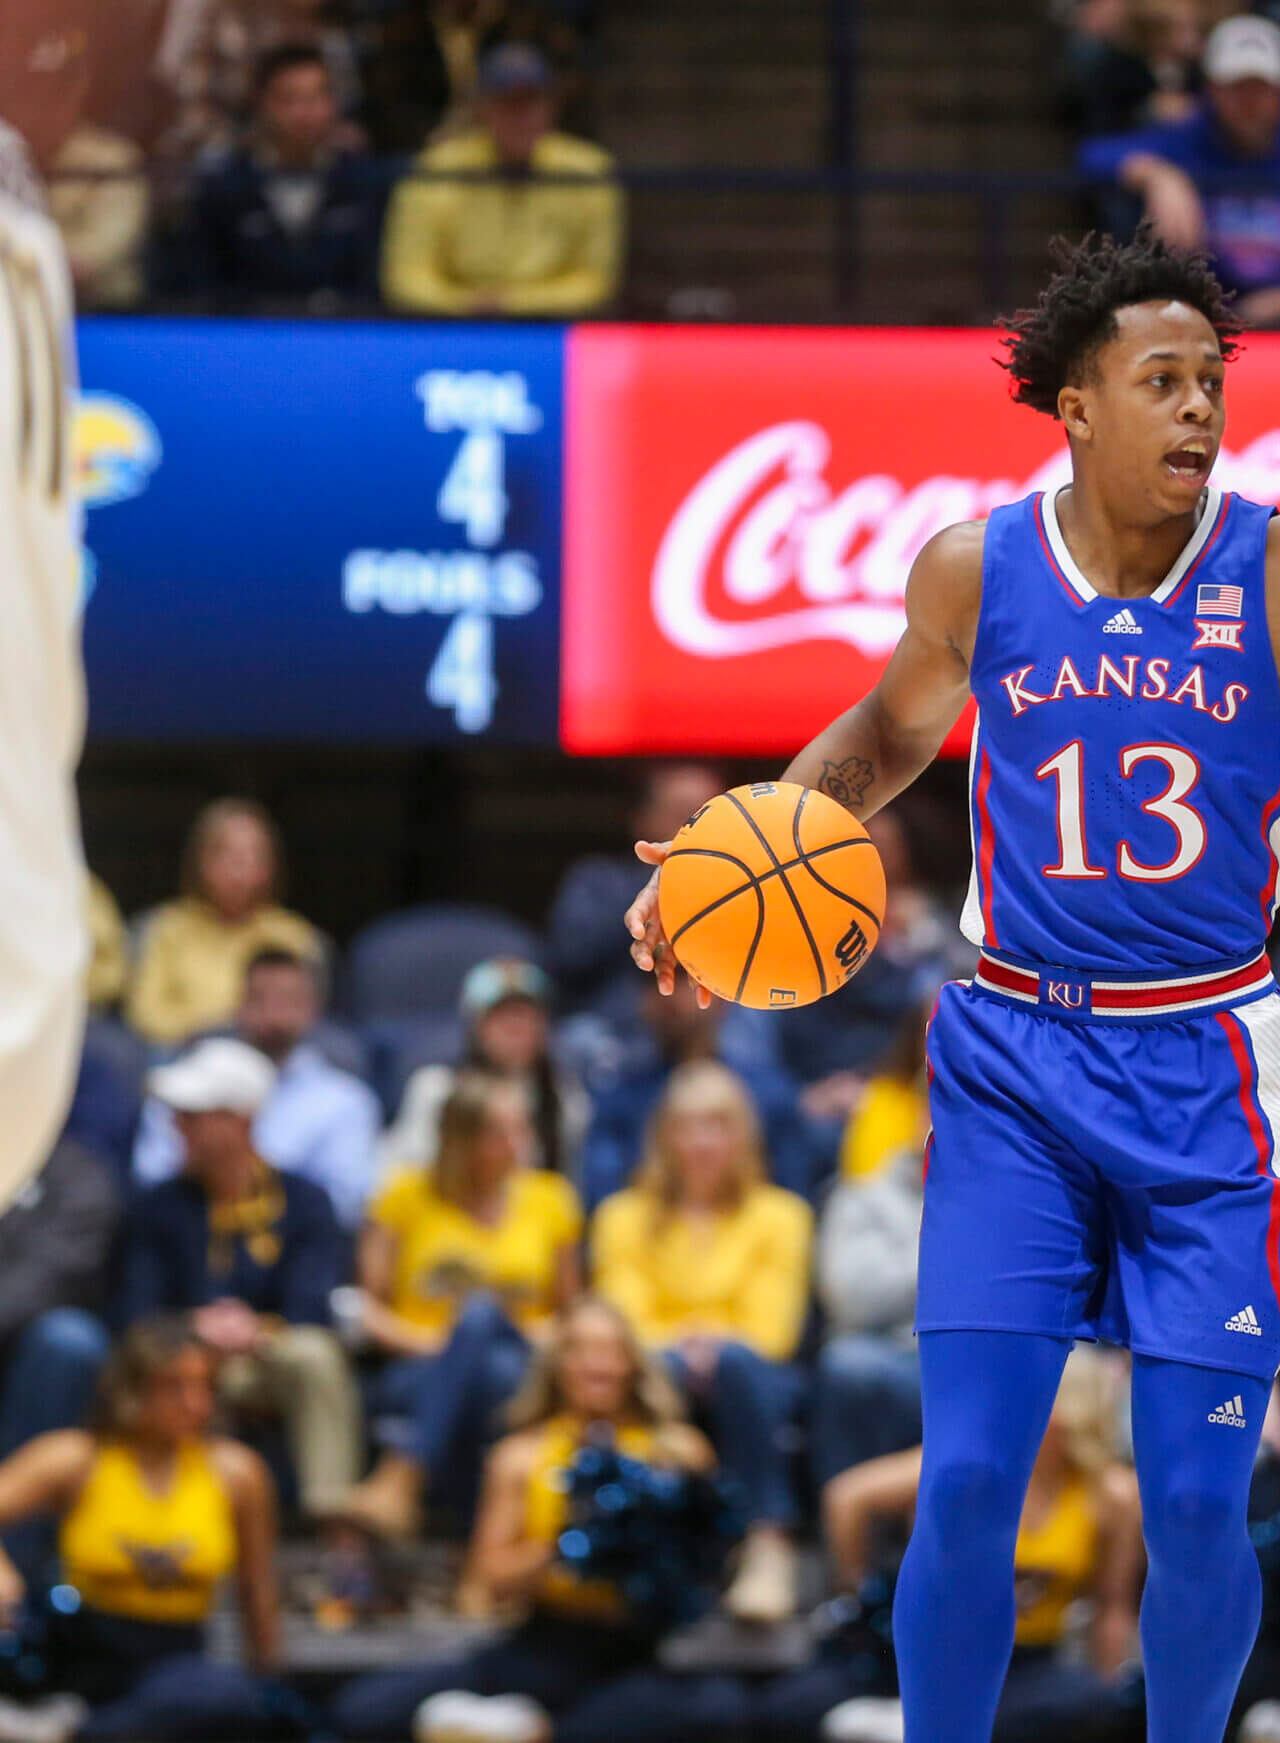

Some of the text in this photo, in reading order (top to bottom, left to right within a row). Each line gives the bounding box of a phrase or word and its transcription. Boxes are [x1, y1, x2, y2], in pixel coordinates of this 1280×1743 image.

[437, 430, 508, 547] 4
[342, 548, 543, 617] FOULS
[1102, 623, 1143, 635] adidas
[1193, 620, 1244, 651] XII
[426, 612, 499, 734] 4
[1001, 654, 1248, 724] KANSAS
[1036, 739, 1207, 883] 13
[1048, 980, 1085, 1009] KU
[1224, 1321, 1262, 1337] adidas
[1207, 1412, 1247, 1429] adidas
